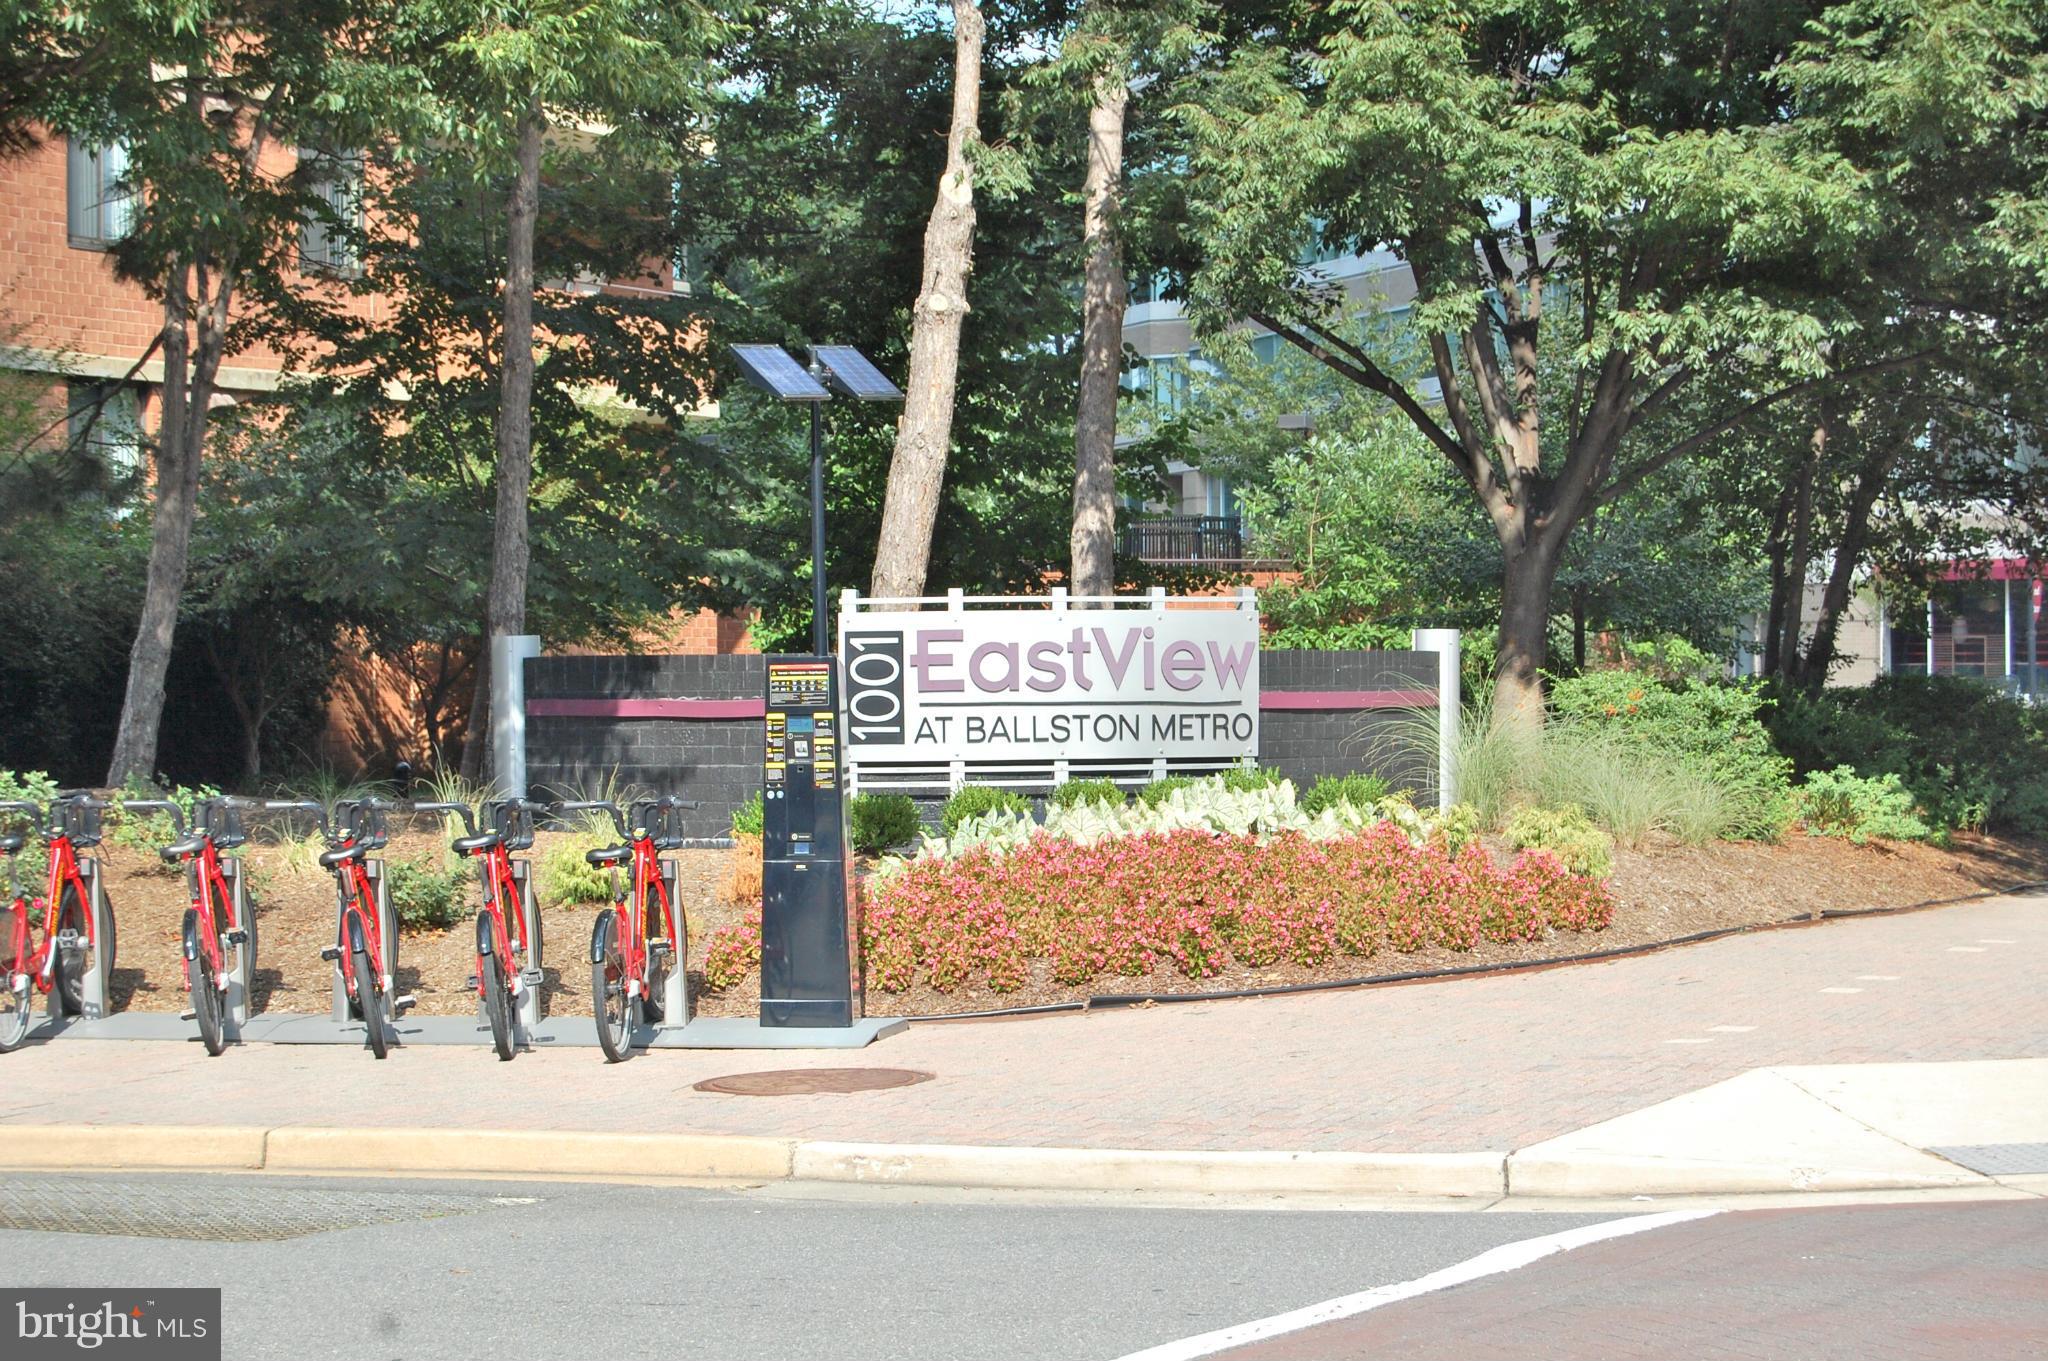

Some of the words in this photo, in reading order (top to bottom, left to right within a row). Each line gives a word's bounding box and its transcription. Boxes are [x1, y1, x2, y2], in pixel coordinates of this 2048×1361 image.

[848, 636, 901, 741] 1001
[909, 626, 1256, 694] EastView
[913, 716, 954, 745] AT
[966, 713, 1140, 744] BALLSTON
[1151, 712, 1254, 742] METRO
